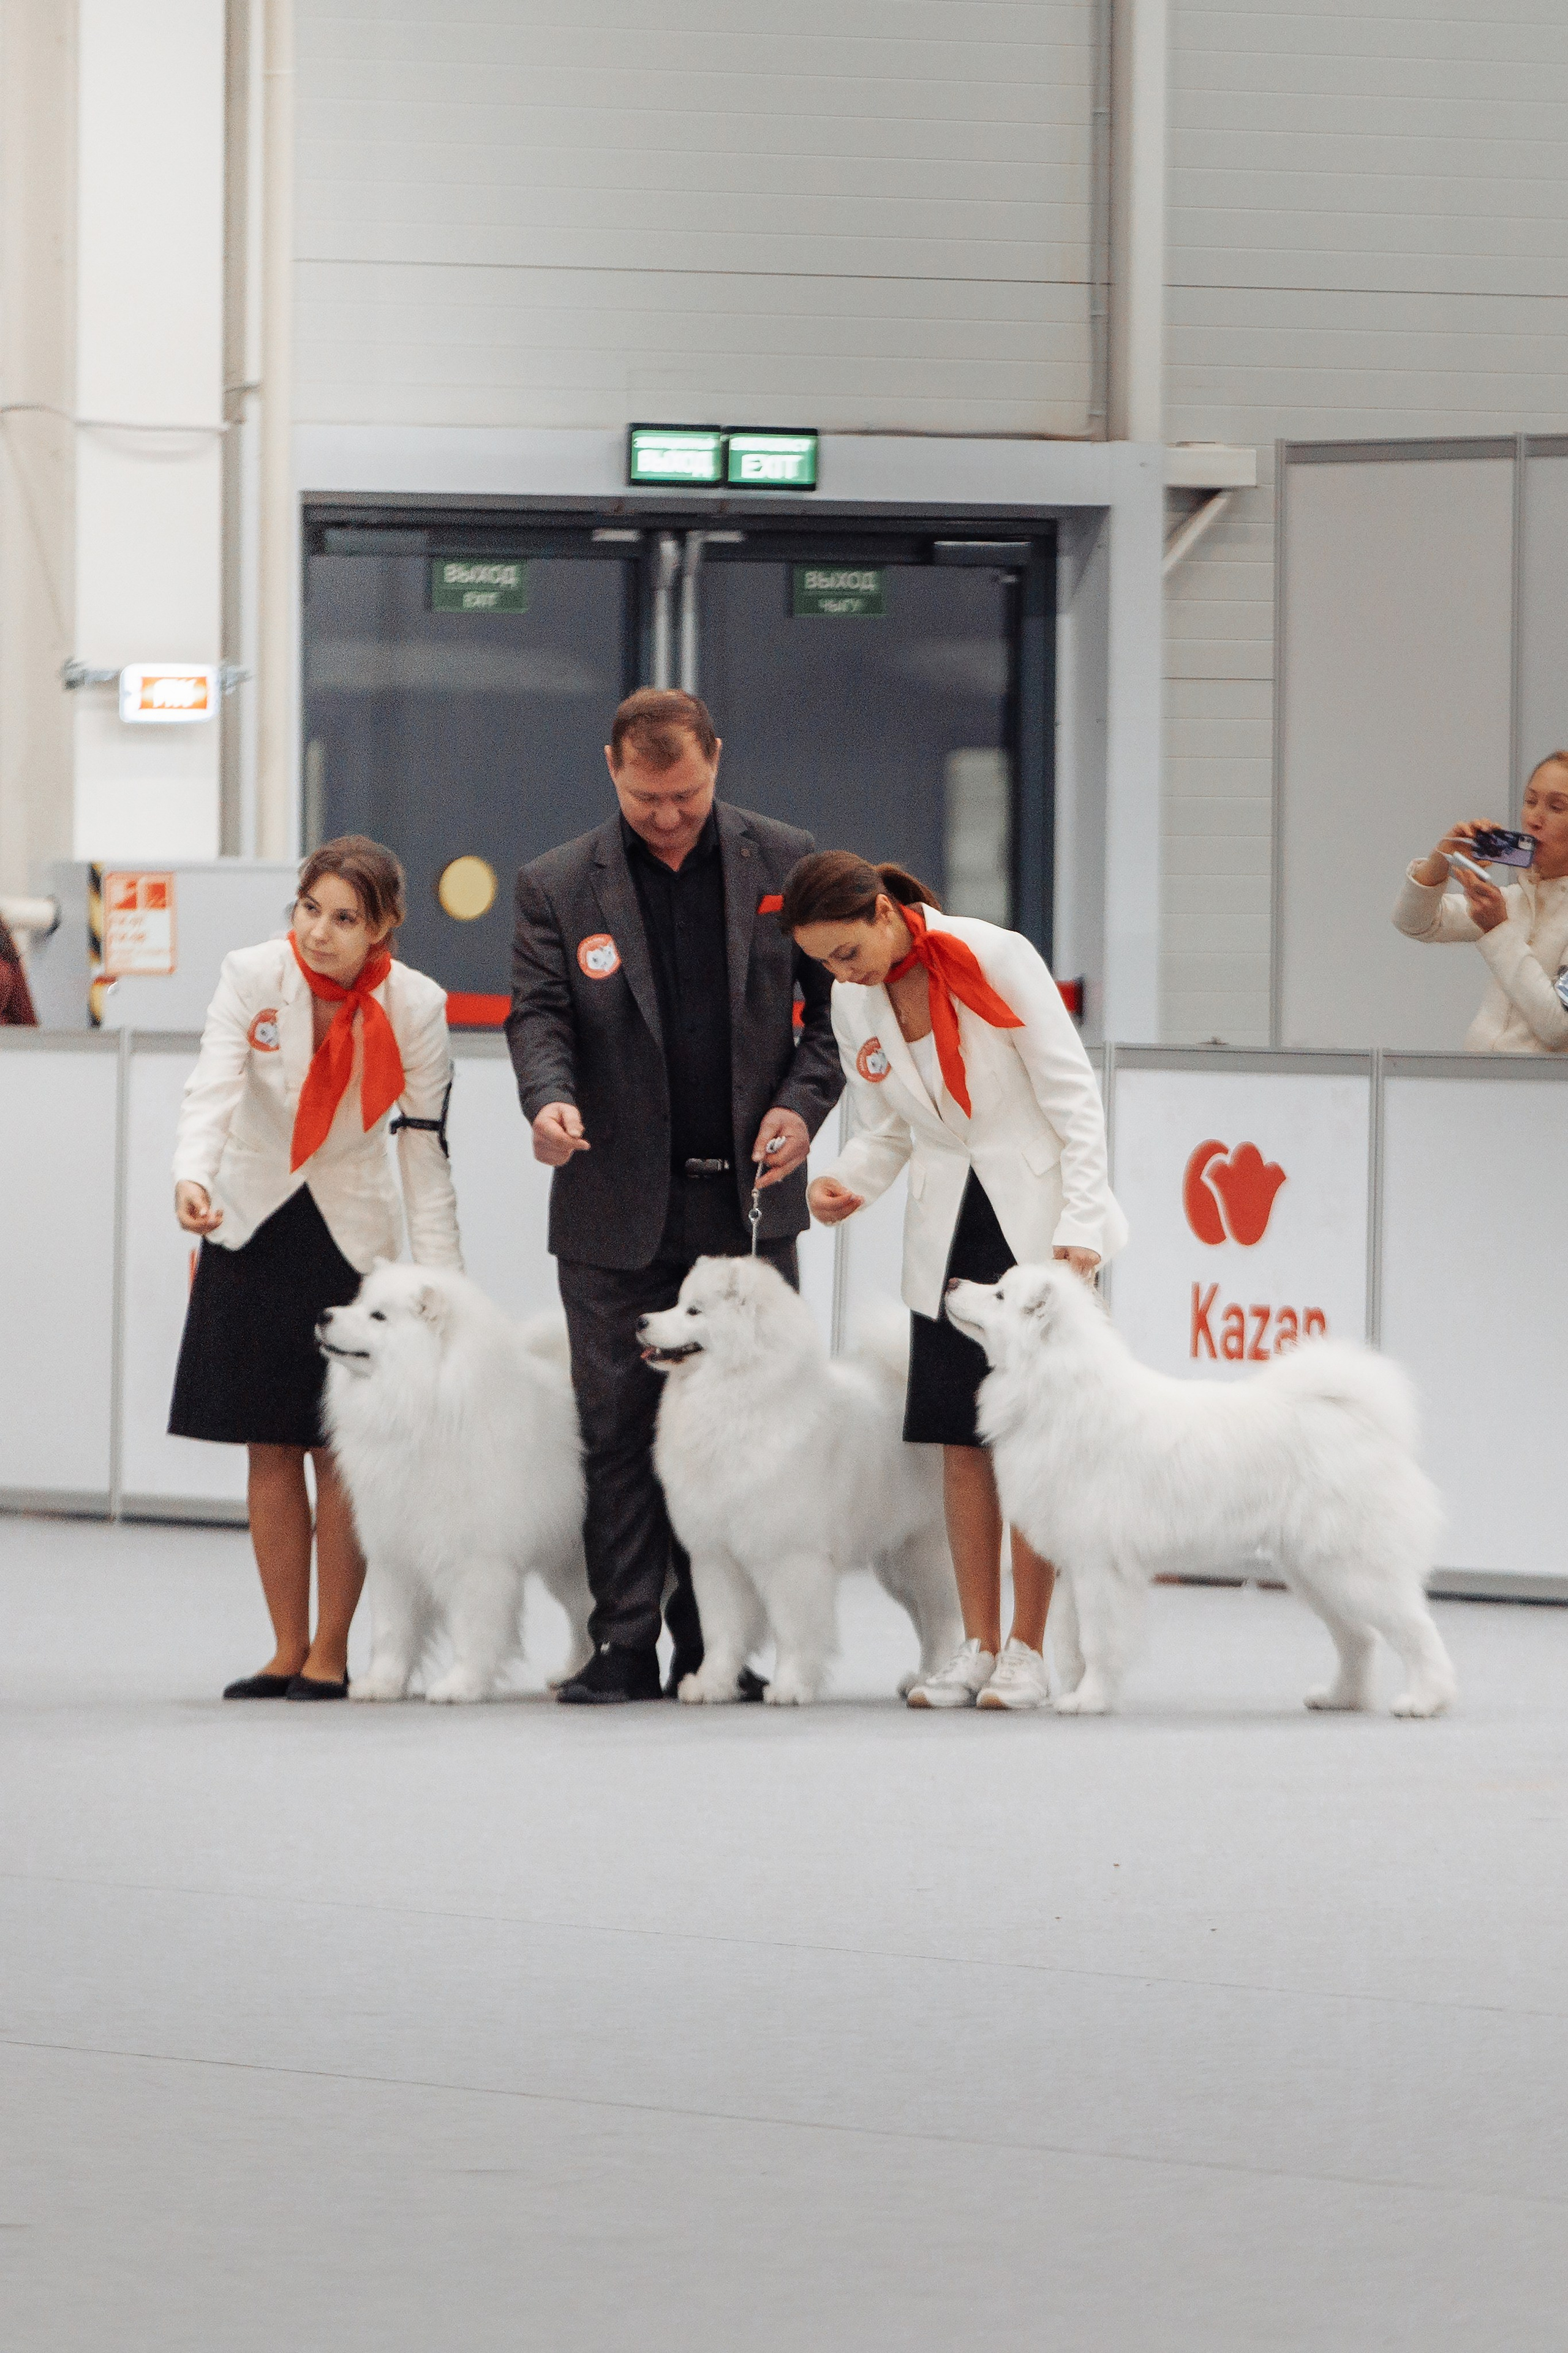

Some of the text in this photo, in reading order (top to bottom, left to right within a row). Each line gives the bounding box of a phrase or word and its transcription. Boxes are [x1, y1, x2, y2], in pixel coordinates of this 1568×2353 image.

[741, 453, 803, 479] EXIT
[444, 563, 516, 587] ВЫХОД
[805, 571, 875, 591] ВЫХОД
